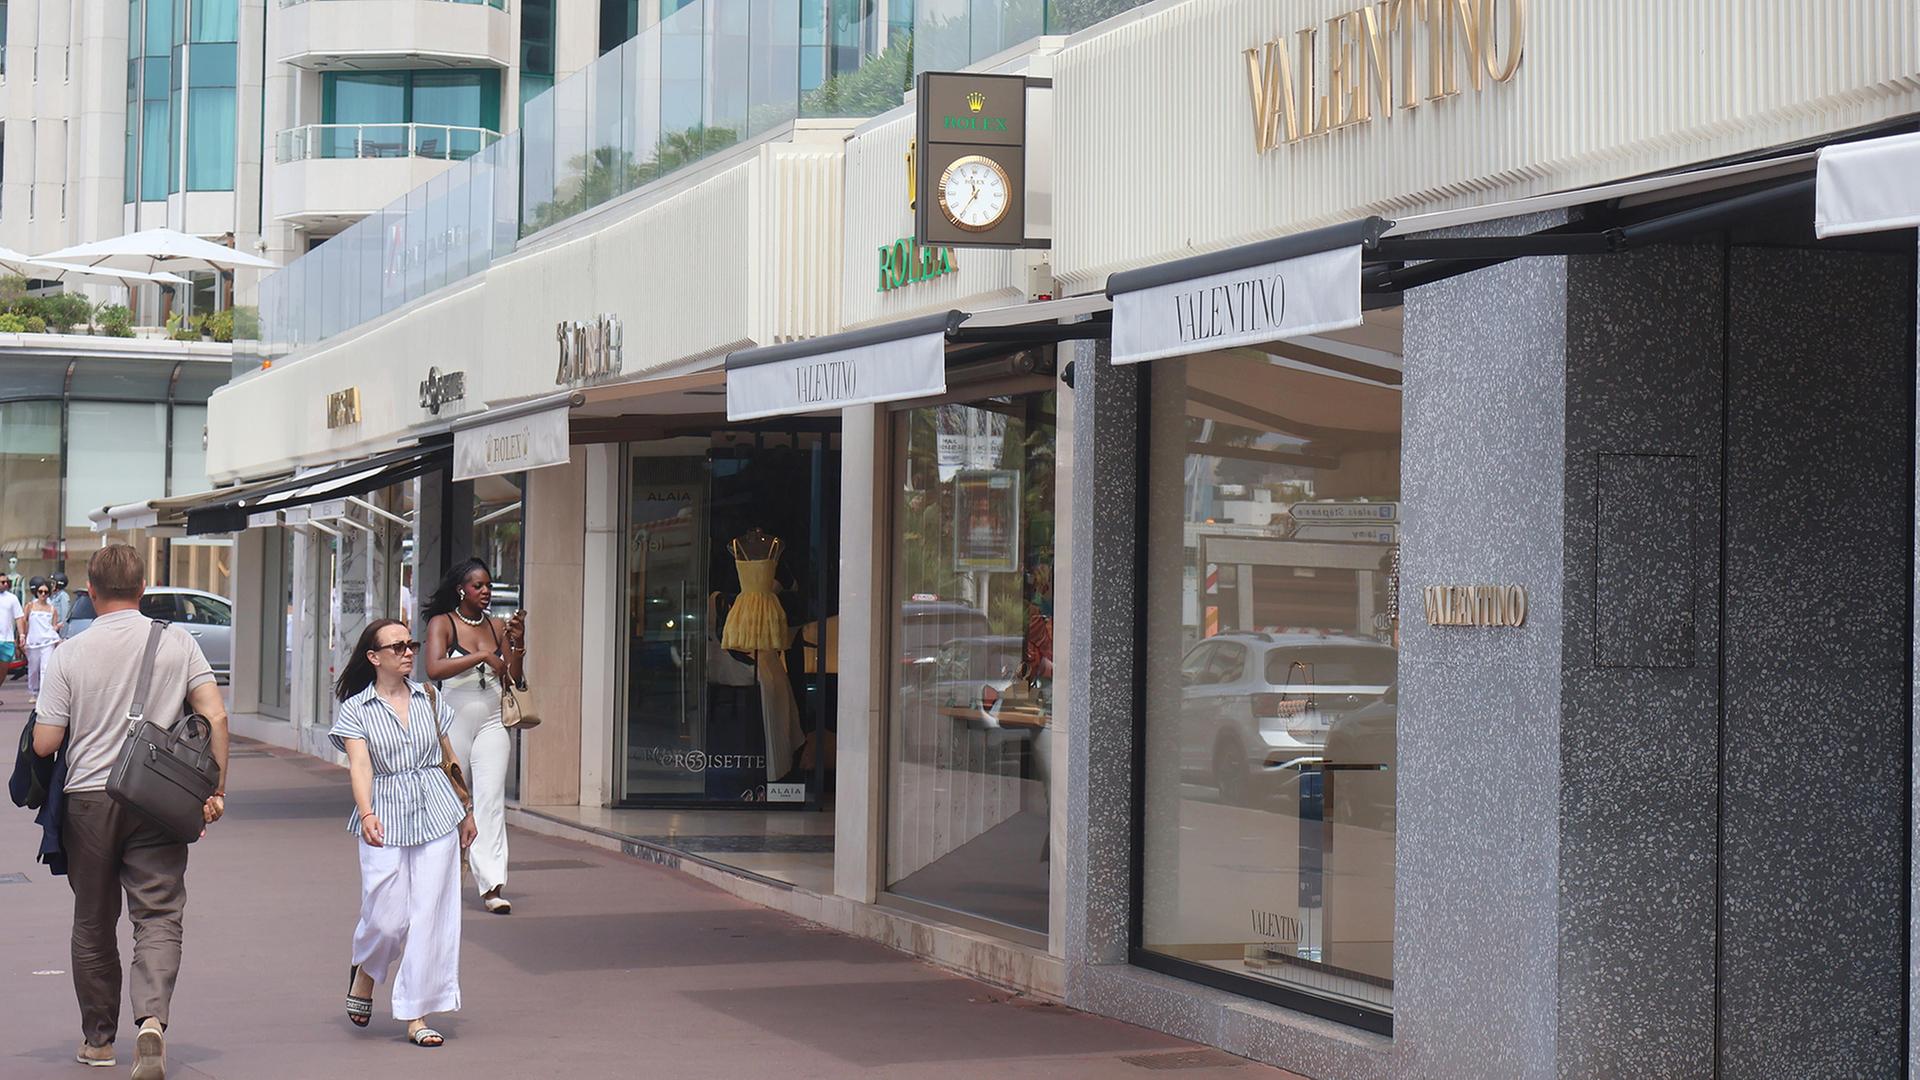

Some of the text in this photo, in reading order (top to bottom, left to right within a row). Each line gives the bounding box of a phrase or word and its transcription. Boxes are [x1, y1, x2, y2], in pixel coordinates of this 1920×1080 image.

[1242, 0, 1527, 157] VALENTINO
[944, 115, 1008, 131] ROLEX
[1174, 274, 1285, 342] VALENTINO
[797, 360, 857, 403] VALENTINO
[493, 434, 521, 462] ROLEX
[1424, 585, 1528, 627] VALENTINO
[1250, 907, 1304, 942] VALENTINO
